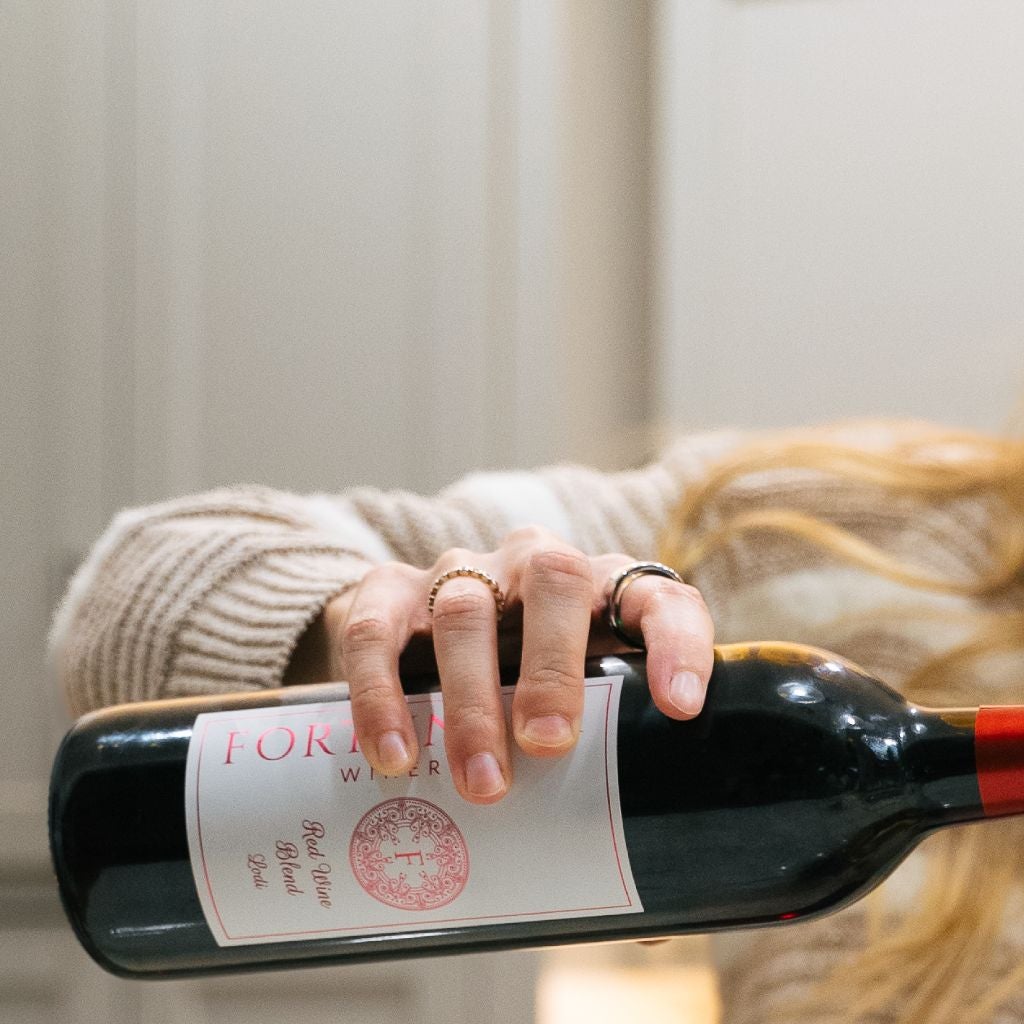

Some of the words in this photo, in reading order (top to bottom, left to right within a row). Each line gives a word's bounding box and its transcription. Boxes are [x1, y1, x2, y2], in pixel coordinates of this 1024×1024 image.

[302, 818, 326, 861] Red
[247, 853, 269, 890] Lodi
[275, 839, 304, 897] Blend
[310, 862, 333, 909] Wine
